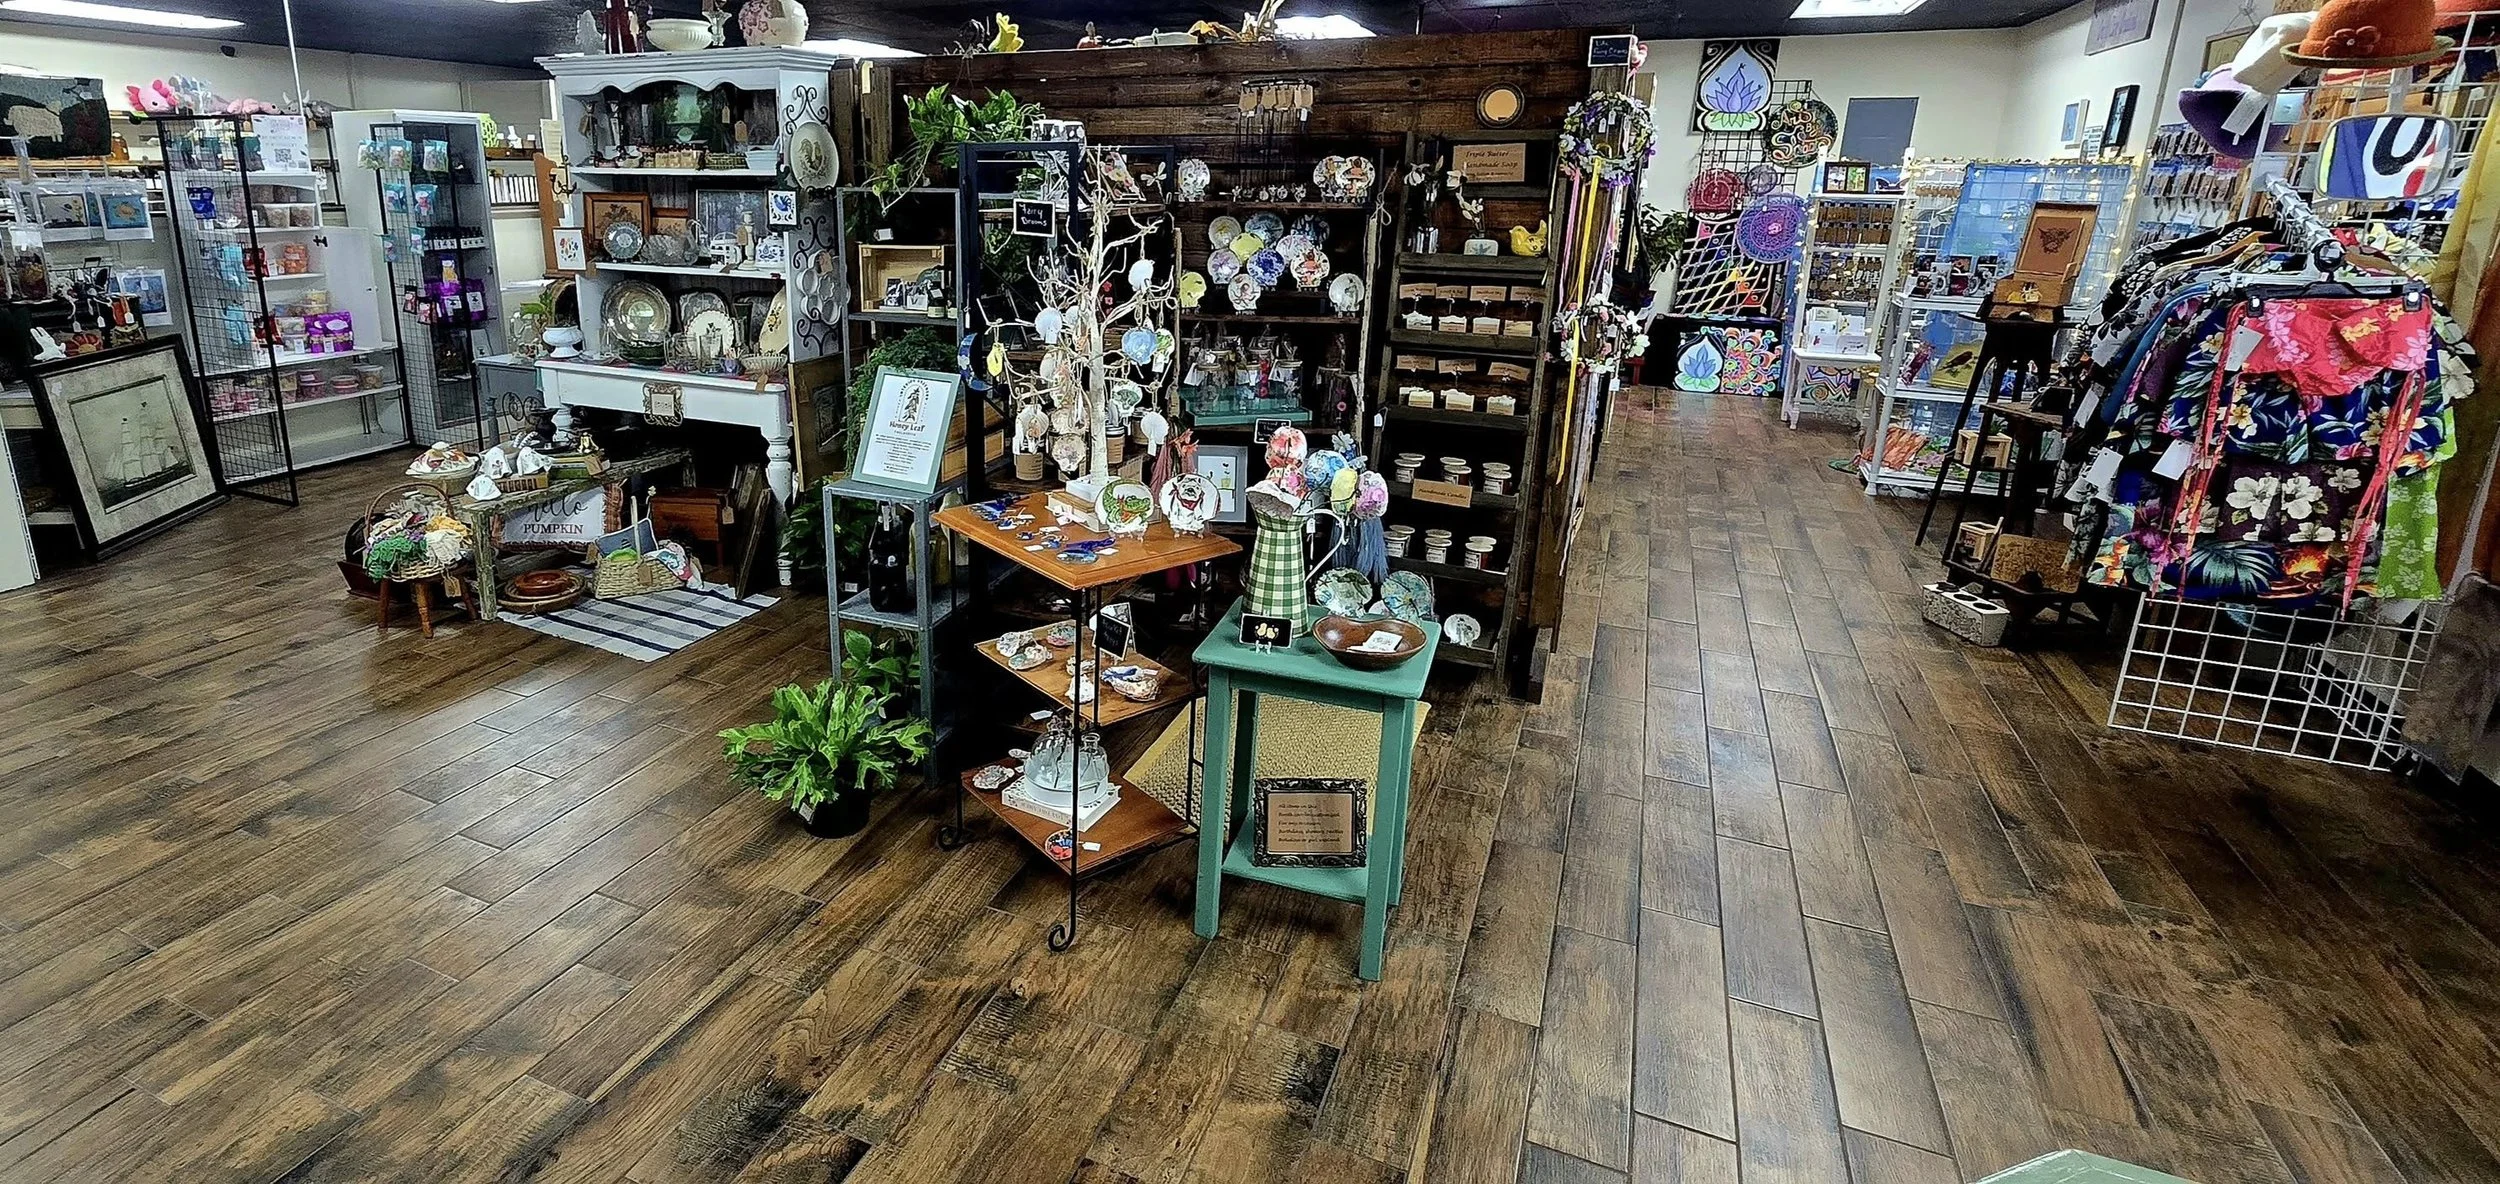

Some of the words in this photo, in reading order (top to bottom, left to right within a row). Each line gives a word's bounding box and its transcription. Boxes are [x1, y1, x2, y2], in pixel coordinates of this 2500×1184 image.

[889, 420, 909, 431] Honey
[910, 421, 926, 432] Leaf
[523, 523, 584, 535] PUMPKIN
